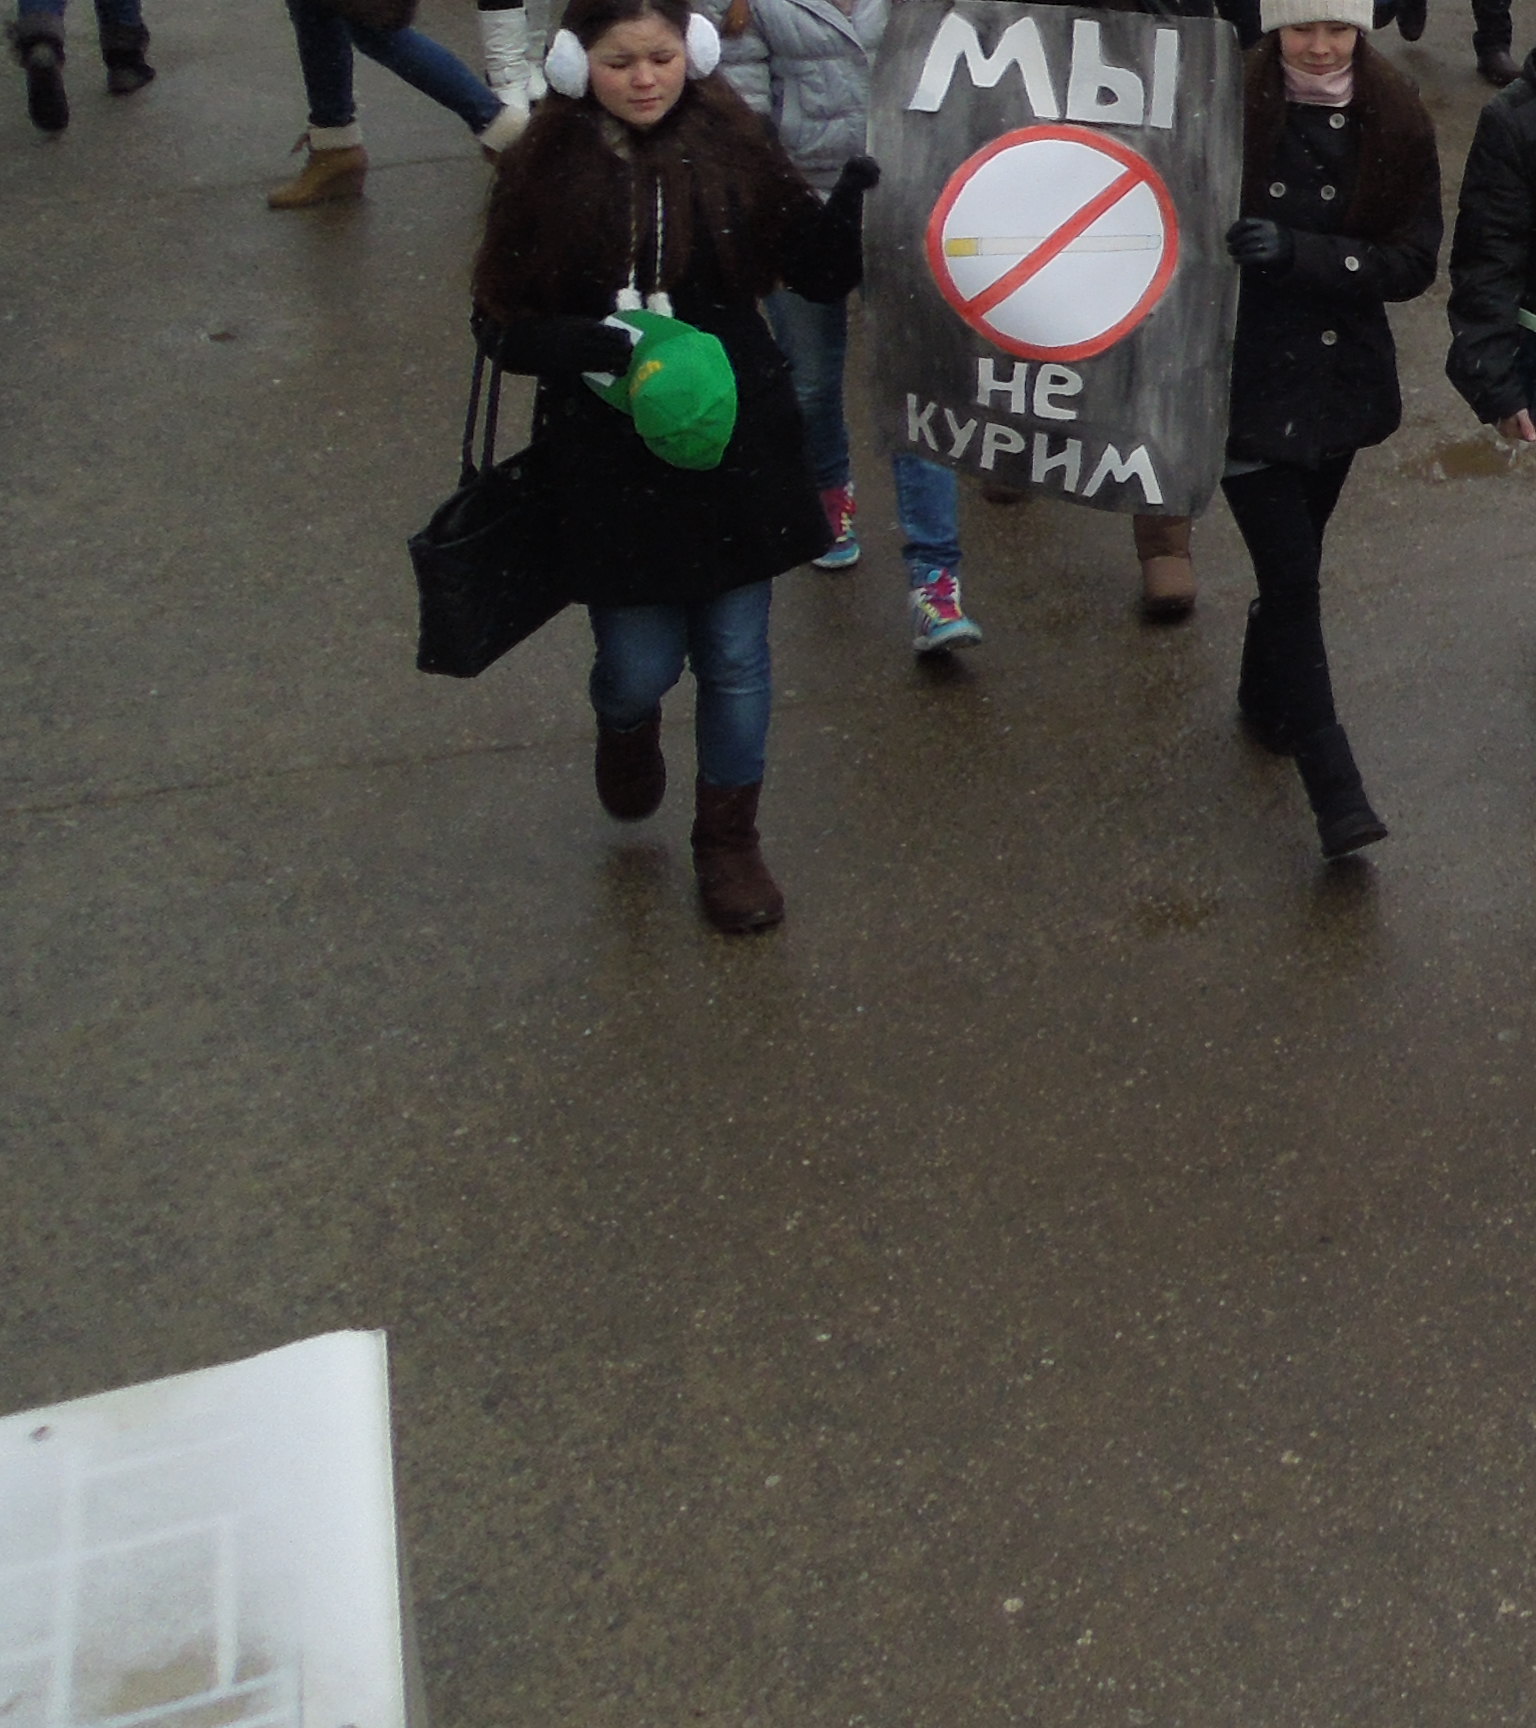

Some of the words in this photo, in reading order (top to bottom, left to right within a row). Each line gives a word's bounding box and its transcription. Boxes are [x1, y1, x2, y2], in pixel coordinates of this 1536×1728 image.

[907, 12, 1178, 129] МЫ
[976, 358, 1084, 420] НЕ
[906, 393, 1164, 505] КУРИМ
